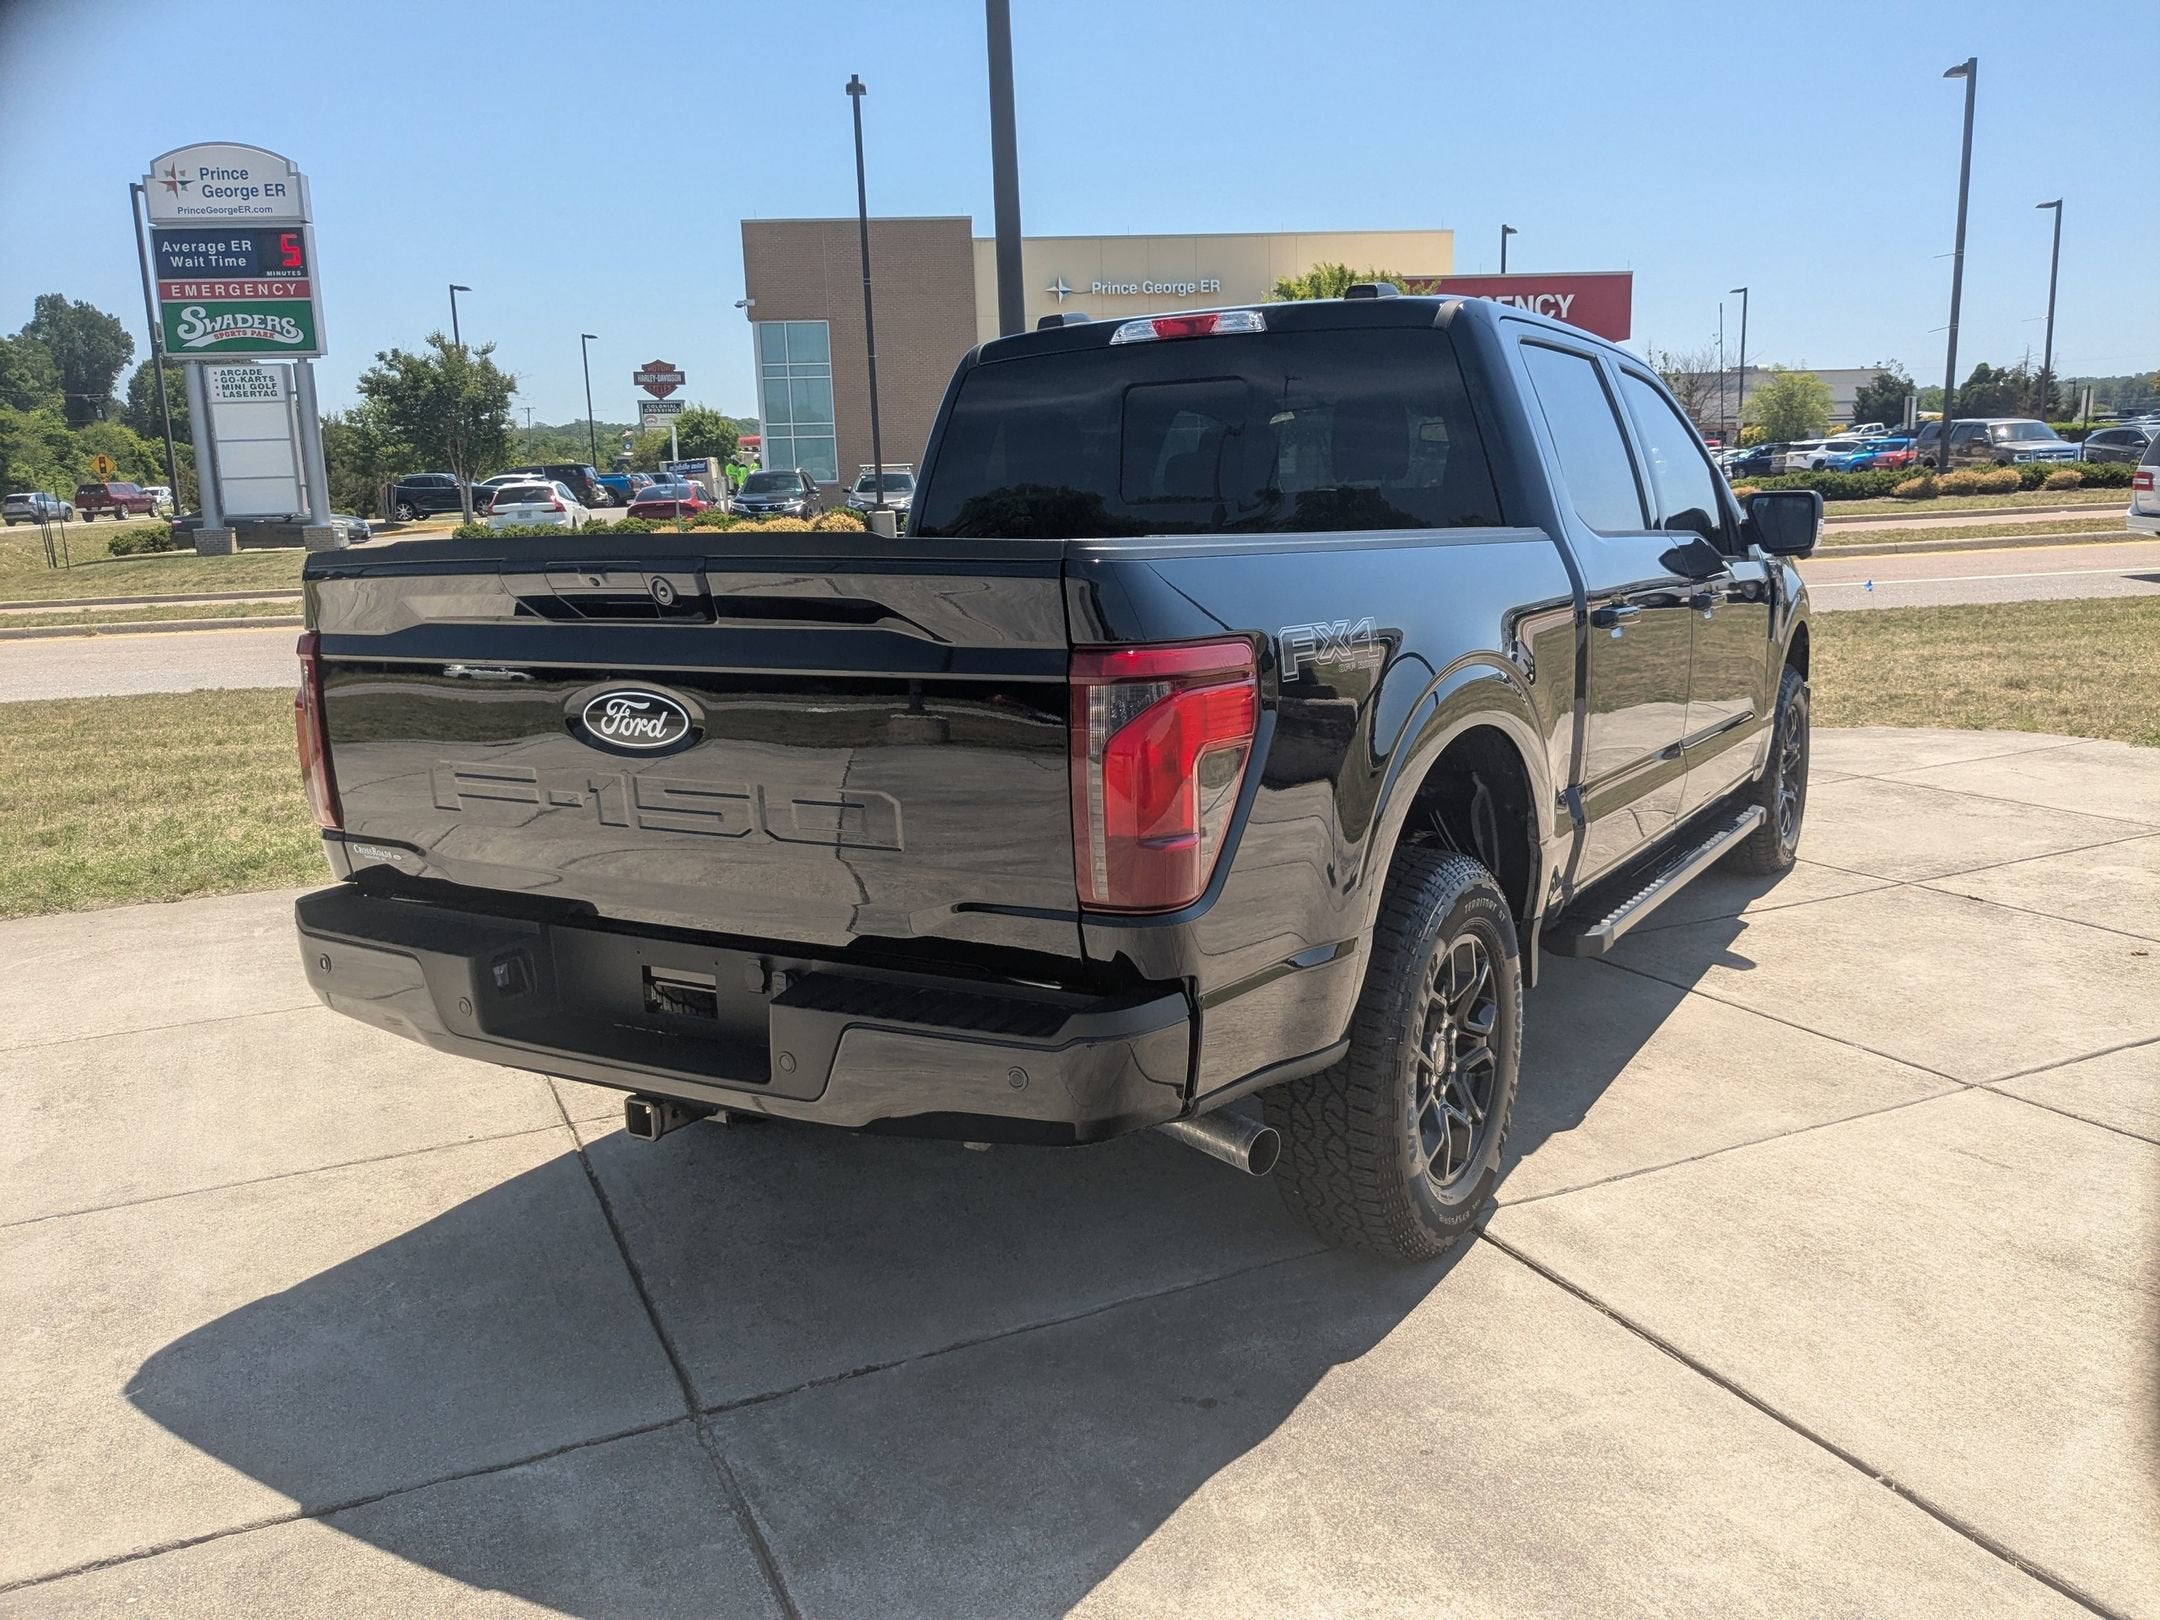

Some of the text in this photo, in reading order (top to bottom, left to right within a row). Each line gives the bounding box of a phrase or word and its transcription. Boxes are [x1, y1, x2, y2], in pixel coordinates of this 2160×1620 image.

[199, 167, 249, 181] Prince
[201, 183, 286, 200] George ER
[177, 205, 273, 216] PrinceGeorgeER.com
[161, 240, 252, 255] Average ER
[280, 233, 302, 268] 5
[170, 256, 247, 267] Wait Time
[171, 283, 298, 297] EMERGENCY
[1091, 279, 1221, 297] Prince George ER
[213, 328, 276, 340] SPORTS PARK
[220, 368, 263, 377] ARCADE
[220, 375, 276, 384] GO-KARTS
[221, 382, 278, 391] MINI GOLF
[222, 389, 278, 398] LASERTAG
[1278, 616, 1381, 682] FX4
[601, 698, 669, 738] Ford
[430, 759, 904, 854] F-150
